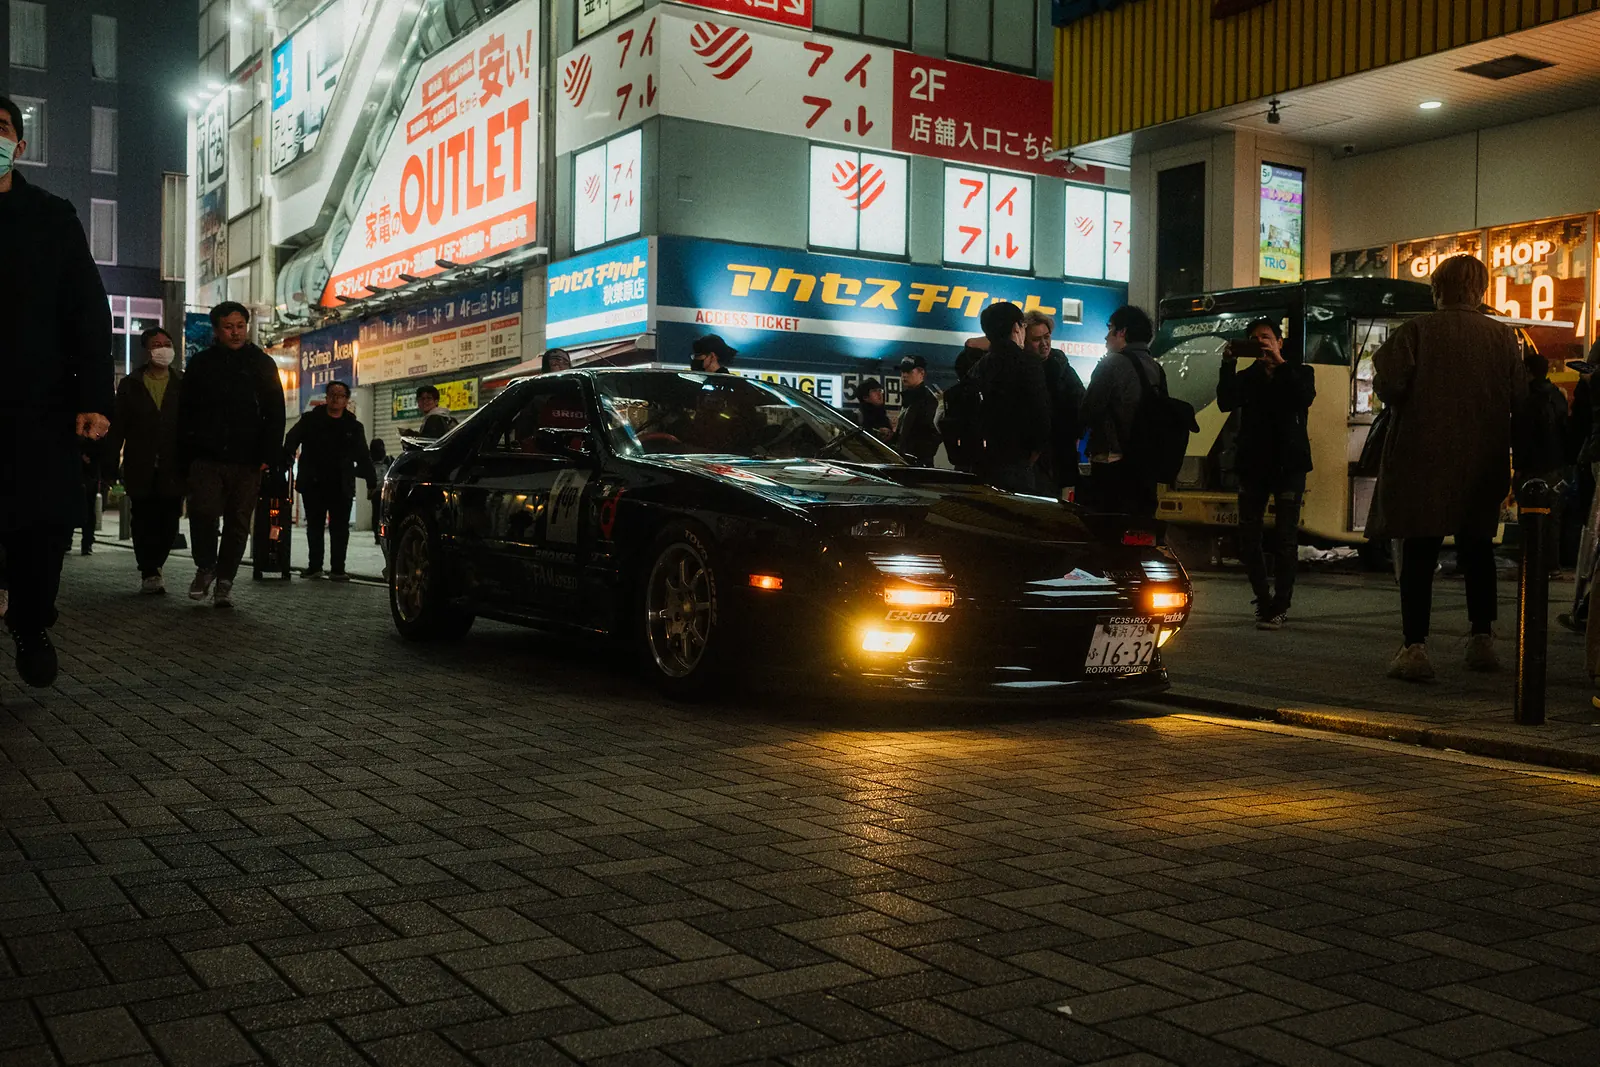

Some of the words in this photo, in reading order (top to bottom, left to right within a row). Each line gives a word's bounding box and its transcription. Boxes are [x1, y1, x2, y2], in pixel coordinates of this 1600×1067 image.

[803, 41, 872, 89] アイ
[910, 66, 947, 102] 2F
[802, 95, 874, 137] フル
[400, 98, 530, 234] OUTLET
[695, 310, 748, 326] ACCESS
[755, 315, 800, 331] TICKET
[1101, 641, 1153, 666] 16-32
